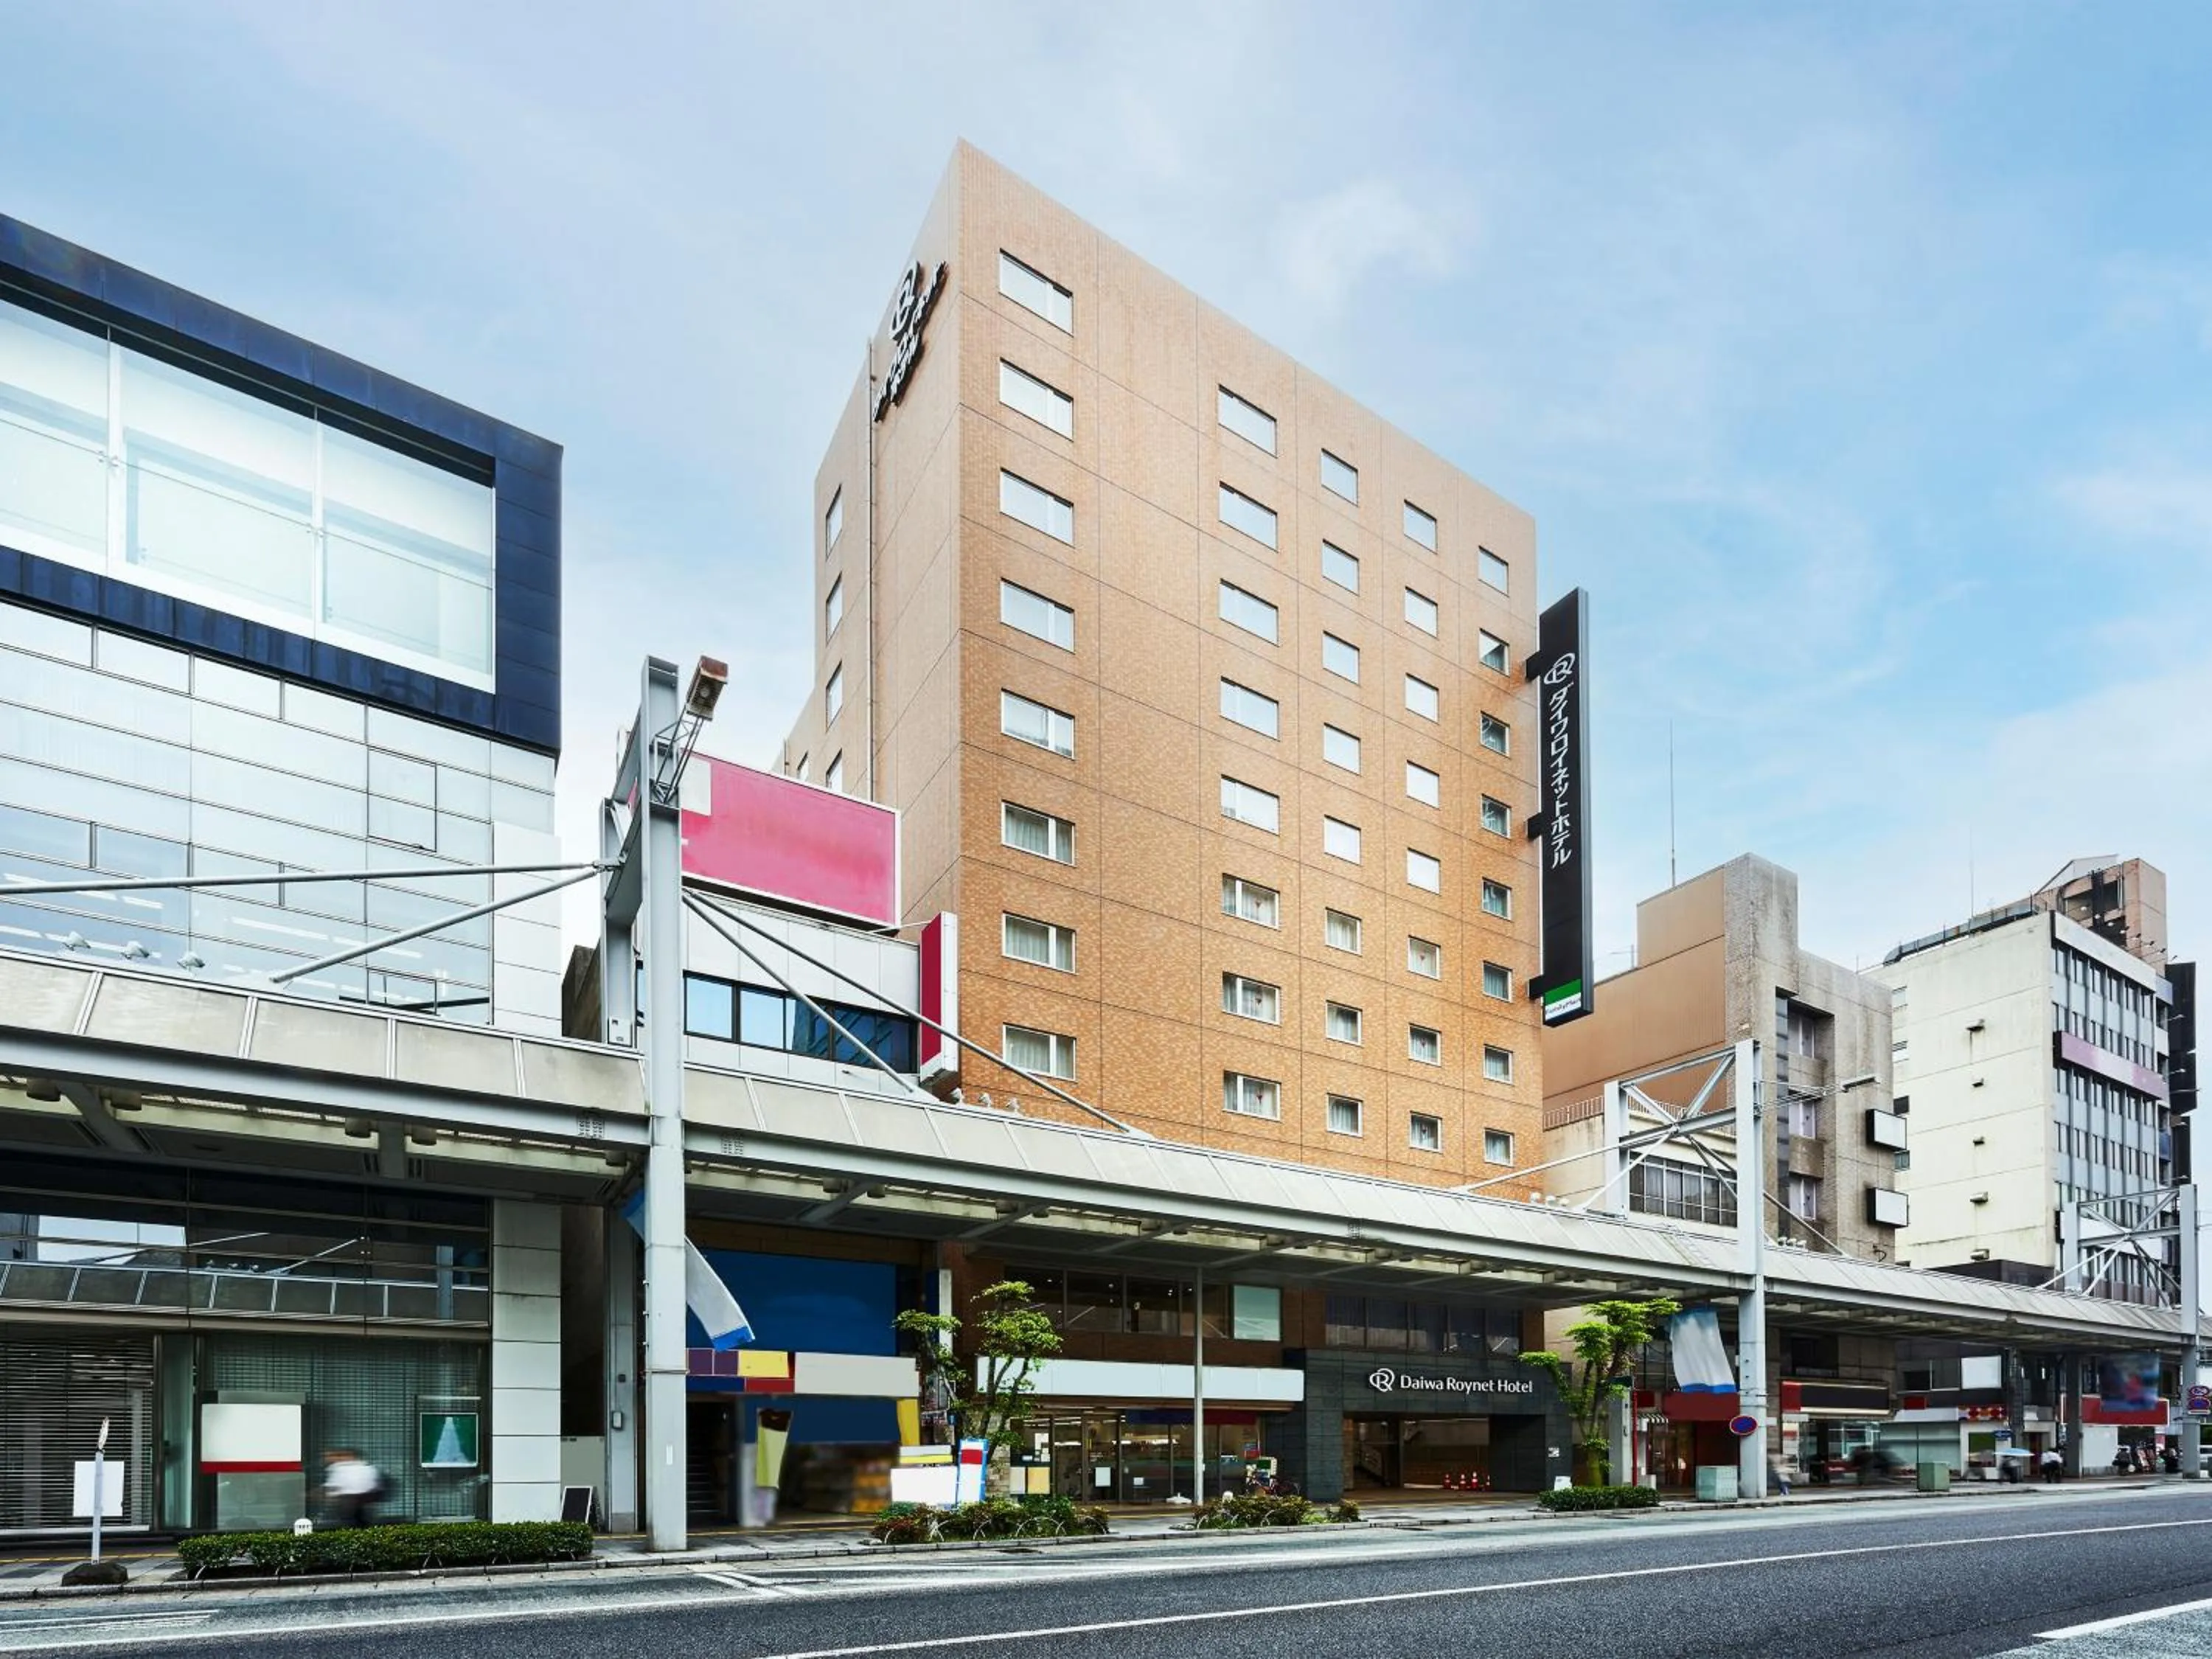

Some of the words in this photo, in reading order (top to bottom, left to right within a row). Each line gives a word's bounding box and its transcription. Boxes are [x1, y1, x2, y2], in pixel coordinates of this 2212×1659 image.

[1549, 681, 1574, 869] ダイワロイネットホテル
[1400, 1374, 1444, 1391] Daiwa
[1446, 1377, 1494, 1395] Roynet
[1498, 1380, 1533, 1393] Hotel
